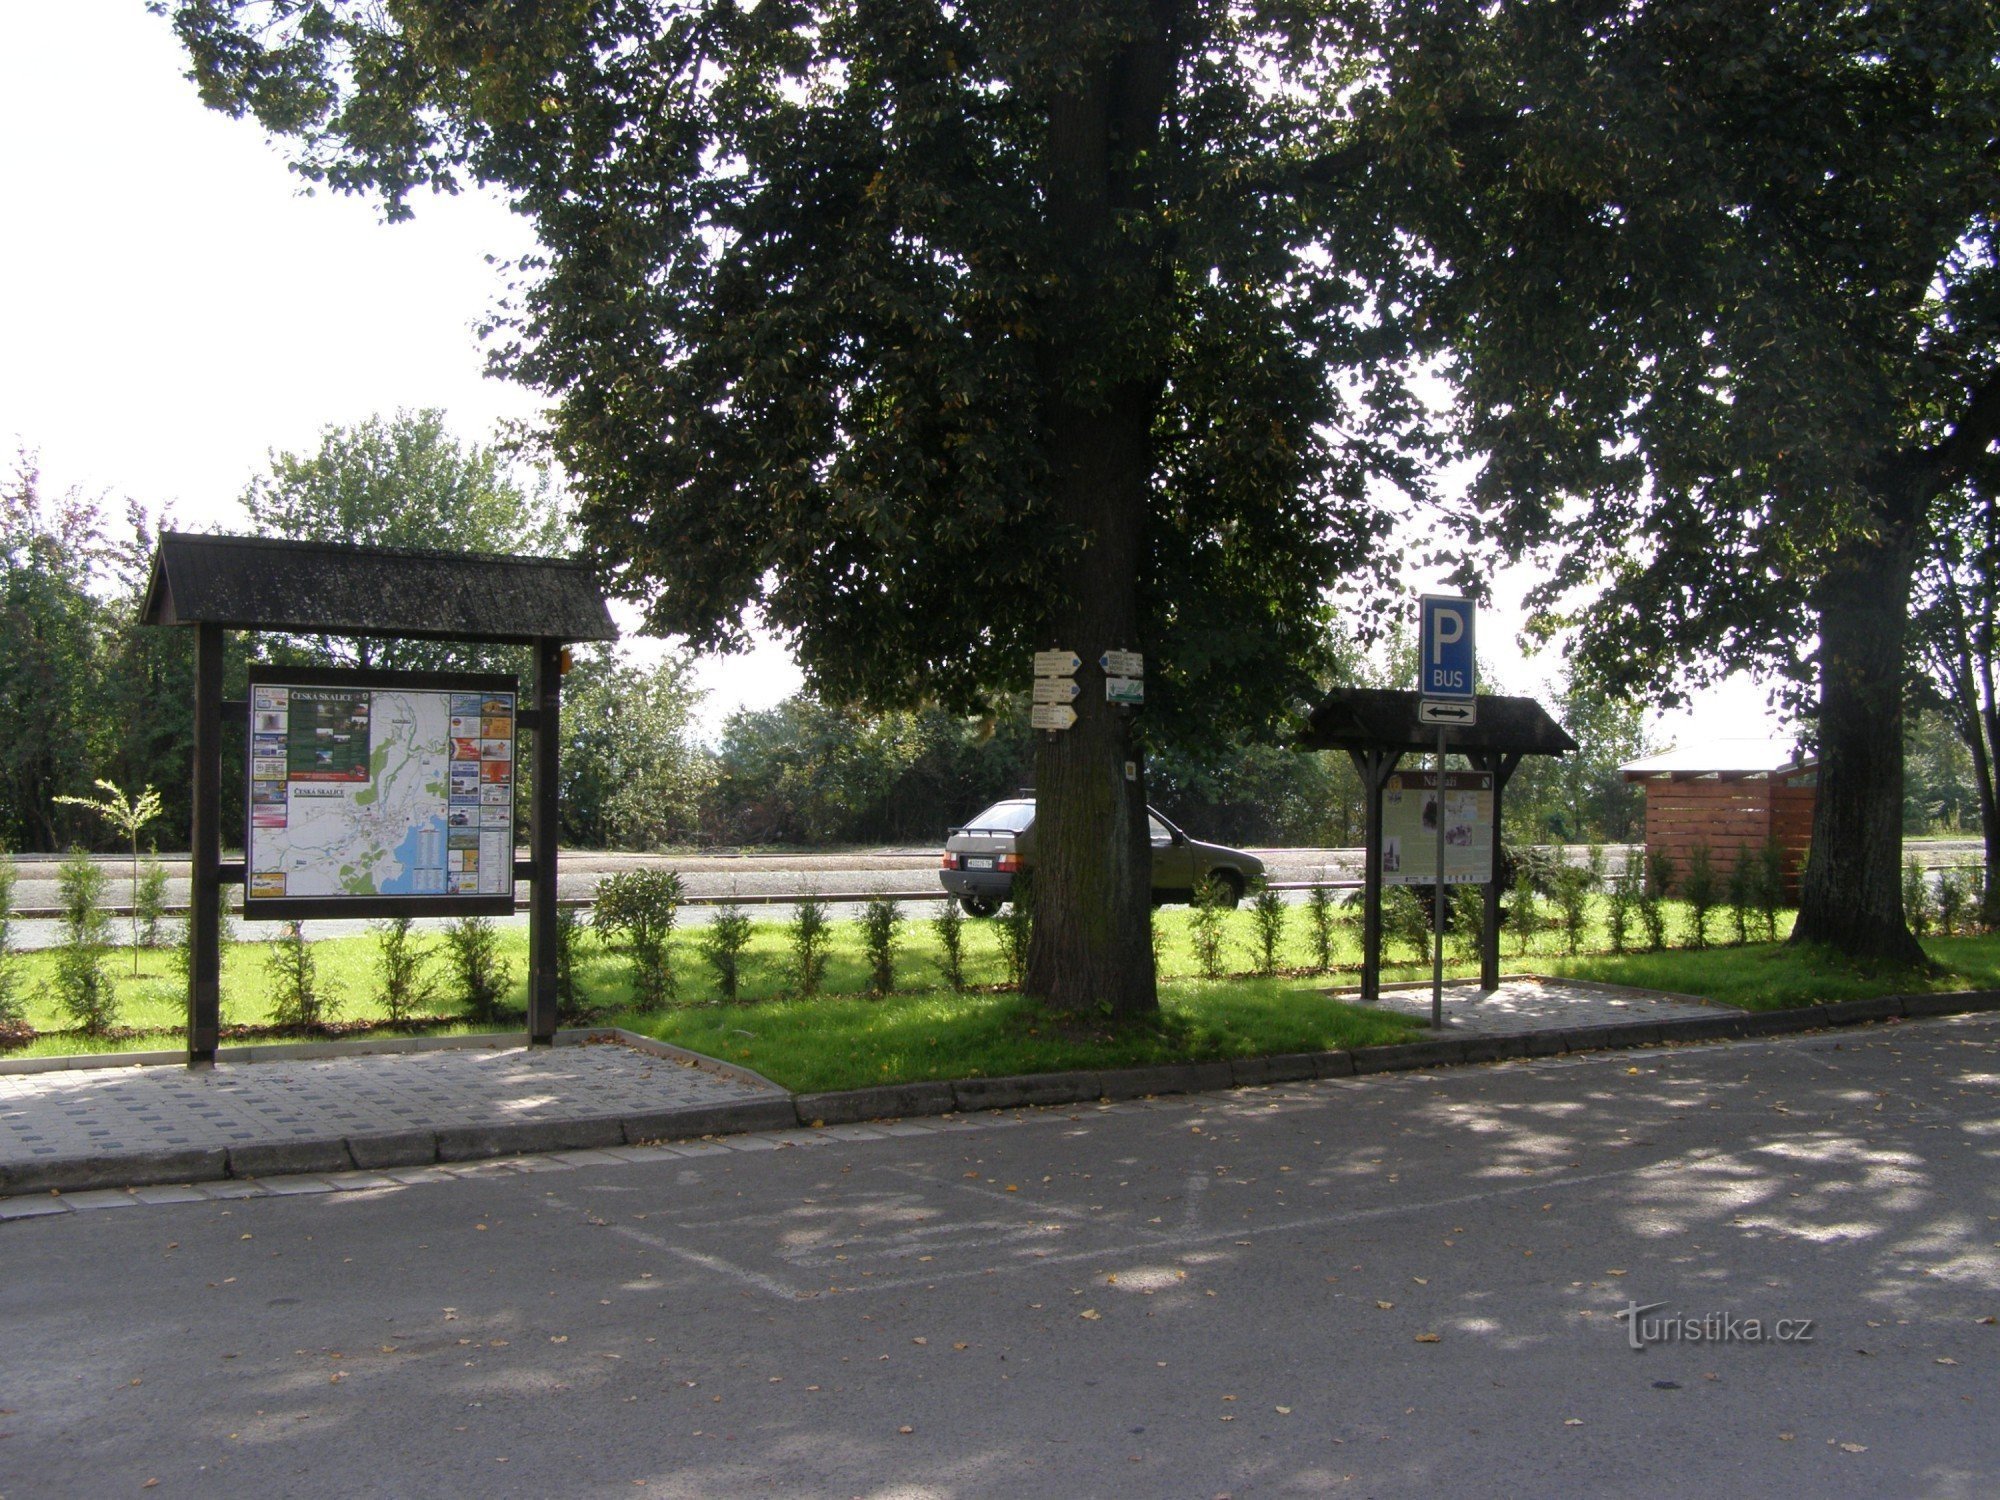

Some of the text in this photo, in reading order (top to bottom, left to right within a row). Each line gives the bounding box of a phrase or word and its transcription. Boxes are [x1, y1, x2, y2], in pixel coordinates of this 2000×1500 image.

[1433, 607, 1464, 665] P
[1433, 669, 1464, 688] BUS
[319, 693, 353, 702] SKALICE
